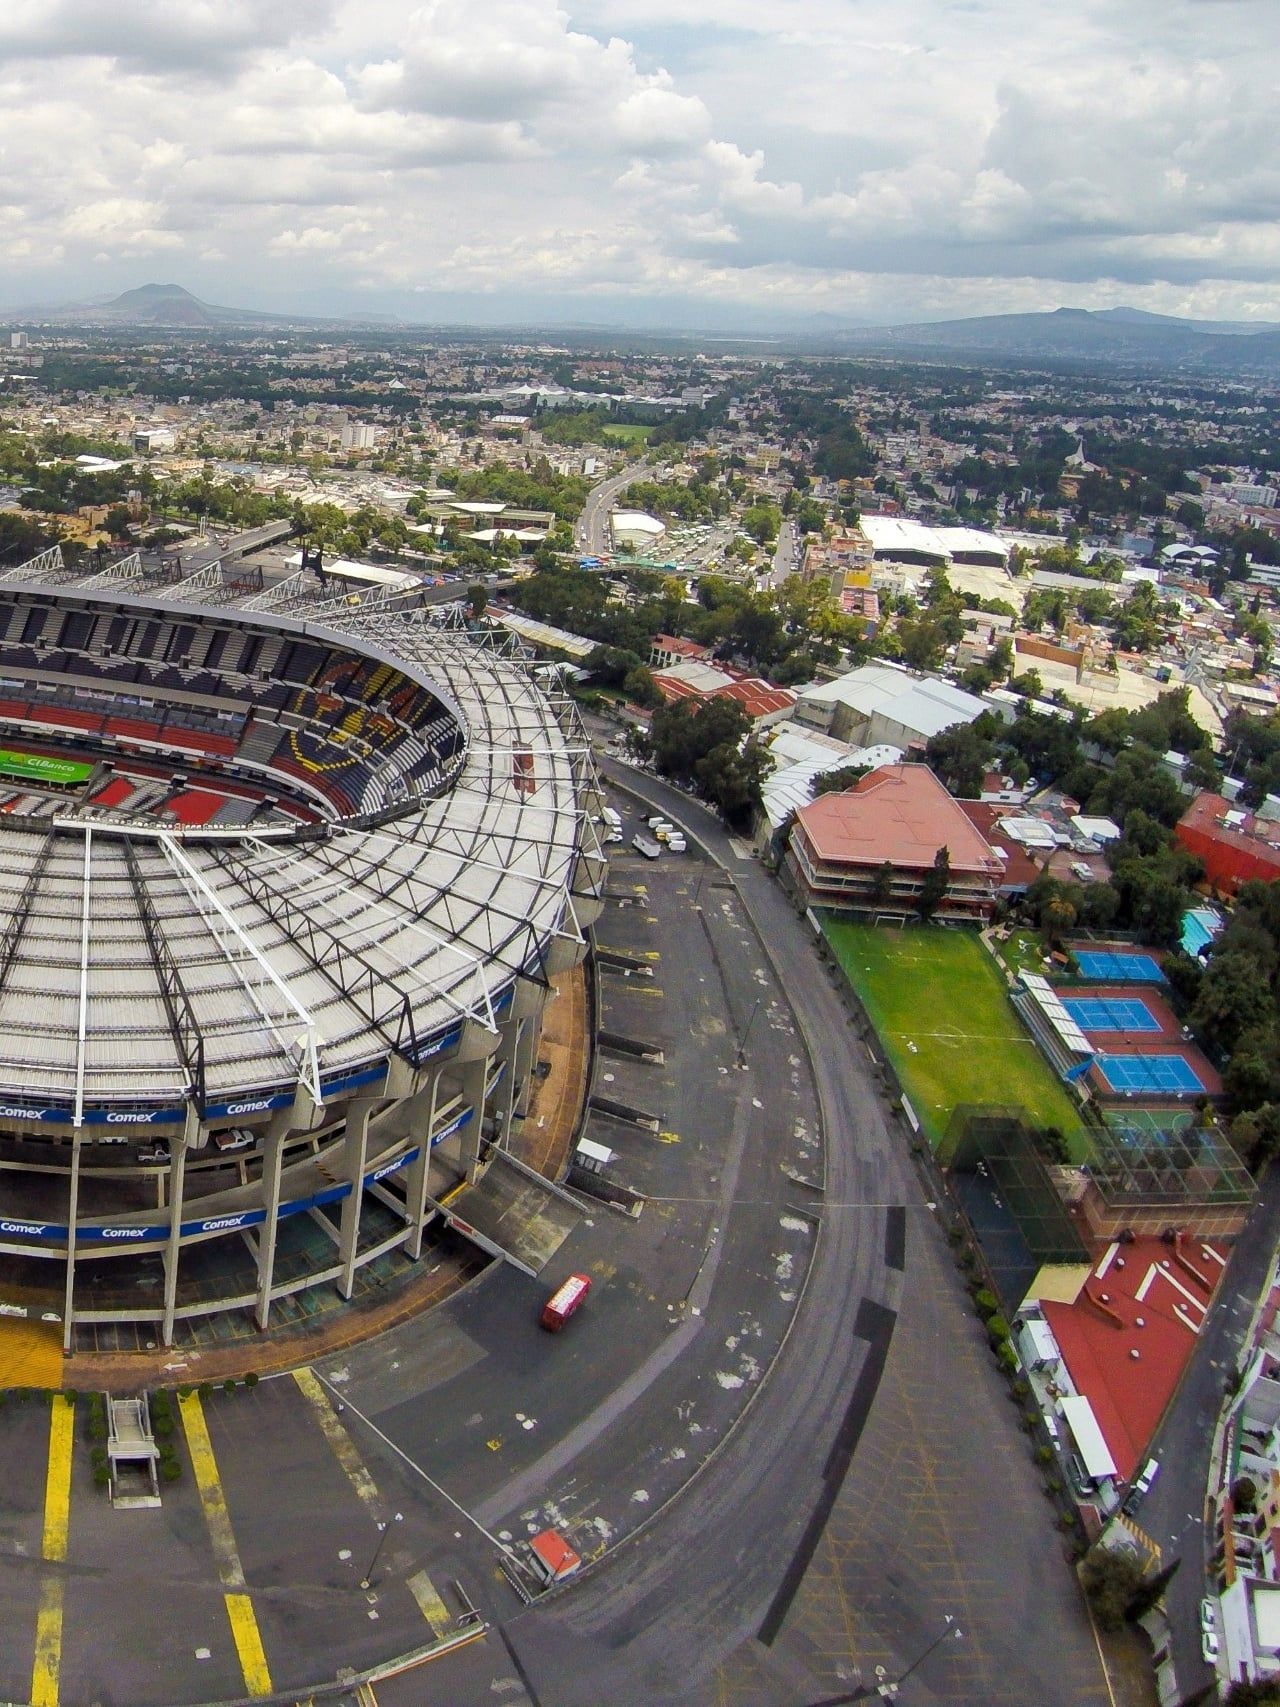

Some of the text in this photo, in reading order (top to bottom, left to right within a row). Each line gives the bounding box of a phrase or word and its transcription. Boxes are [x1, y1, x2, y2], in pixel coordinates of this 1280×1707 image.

[412, 1041, 444, 1060] omex
[227, 1097, 273, 1114] Comex
[107, 1112, 156, 1123] Comex
[373, 1158, 405, 1180] Comex
[1, 1222, 46, 1235] Comex
[202, 1215, 247, 1231] Comex
[102, 1226, 149, 1238] Comex
